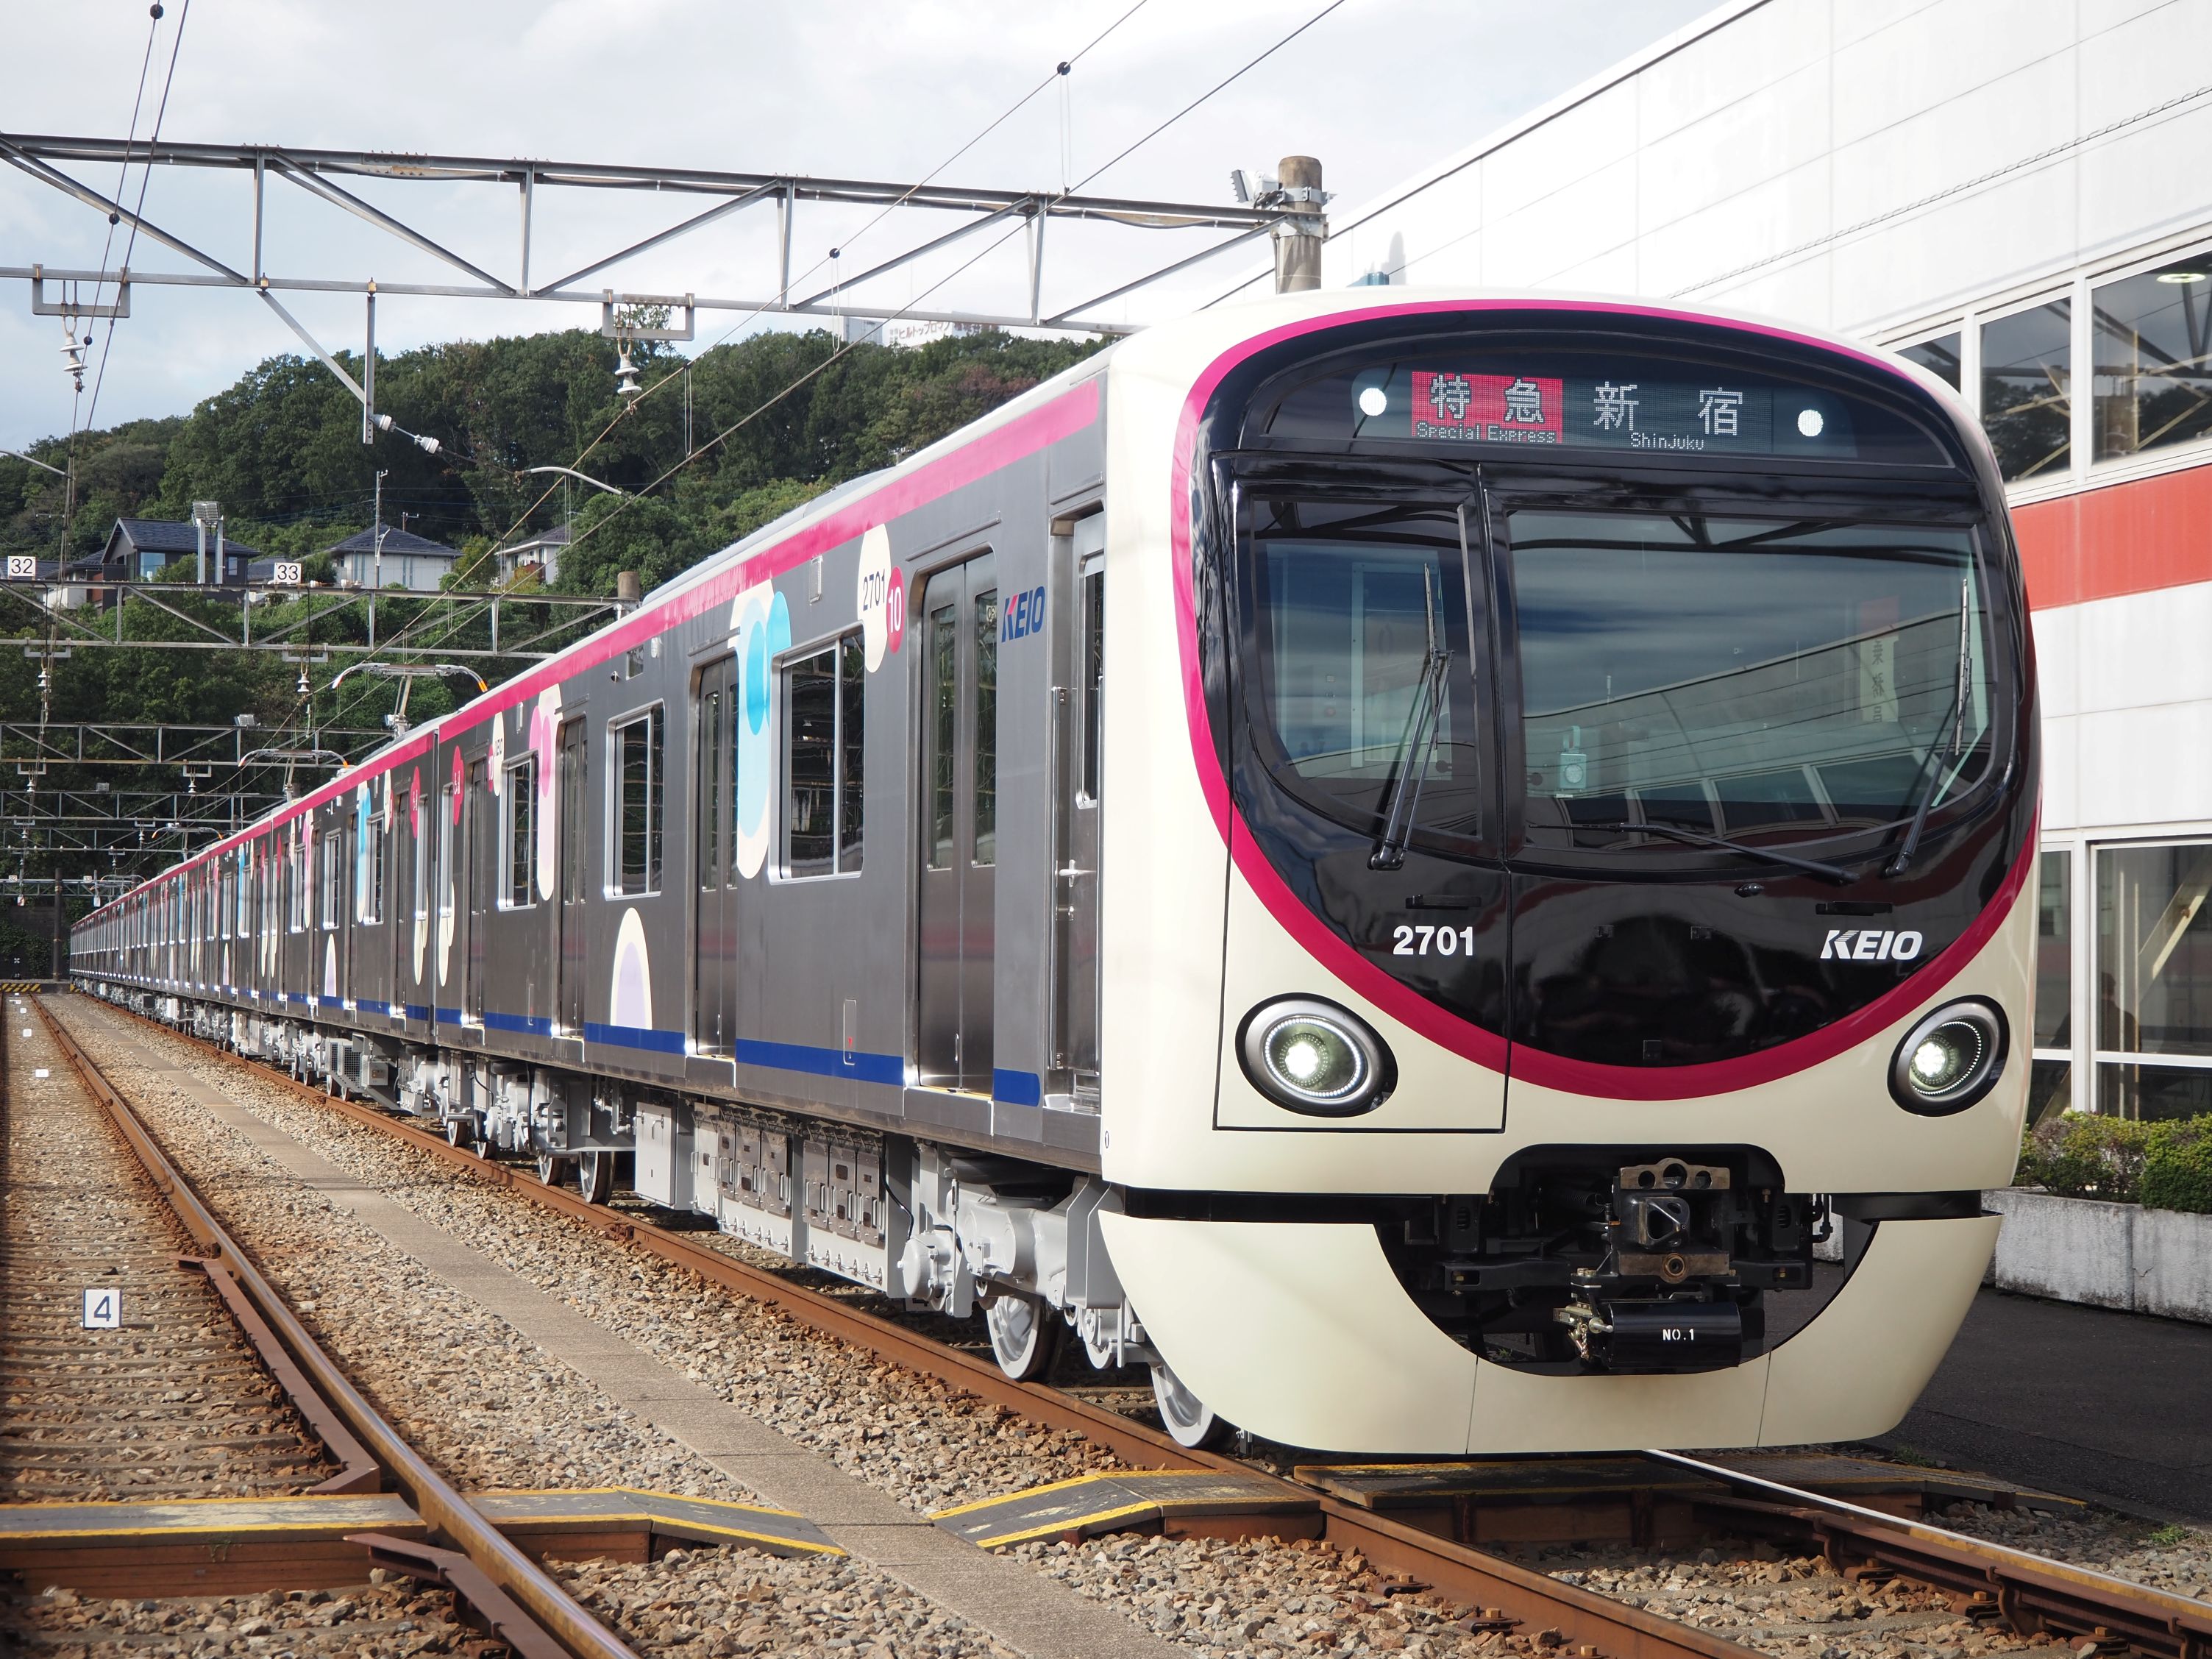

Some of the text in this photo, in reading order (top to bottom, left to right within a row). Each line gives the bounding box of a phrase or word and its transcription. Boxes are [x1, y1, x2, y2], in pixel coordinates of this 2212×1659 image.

[1431, 374, 1544, 423] 特急
[1593, 381, 1743, 436] 新宿
[1417, 422, 1555, 444] Special Express
[1630, 432, 1704, 450] Shinjuku
[11, 558, 33, 574] 32
[277, 564, 299, 580] 33
[863, 569, 885, 611] 2701
[888, 586, 902, 633] 10
[1001, 586, 1045, 643] KEIO
[1393, 925, 1473, 956] 2701
[1819, 929, 1923, 961] KEIO
[93, 1295, 112, 1322] 4
[1662, 1328, 1694, 1340] NO.1
